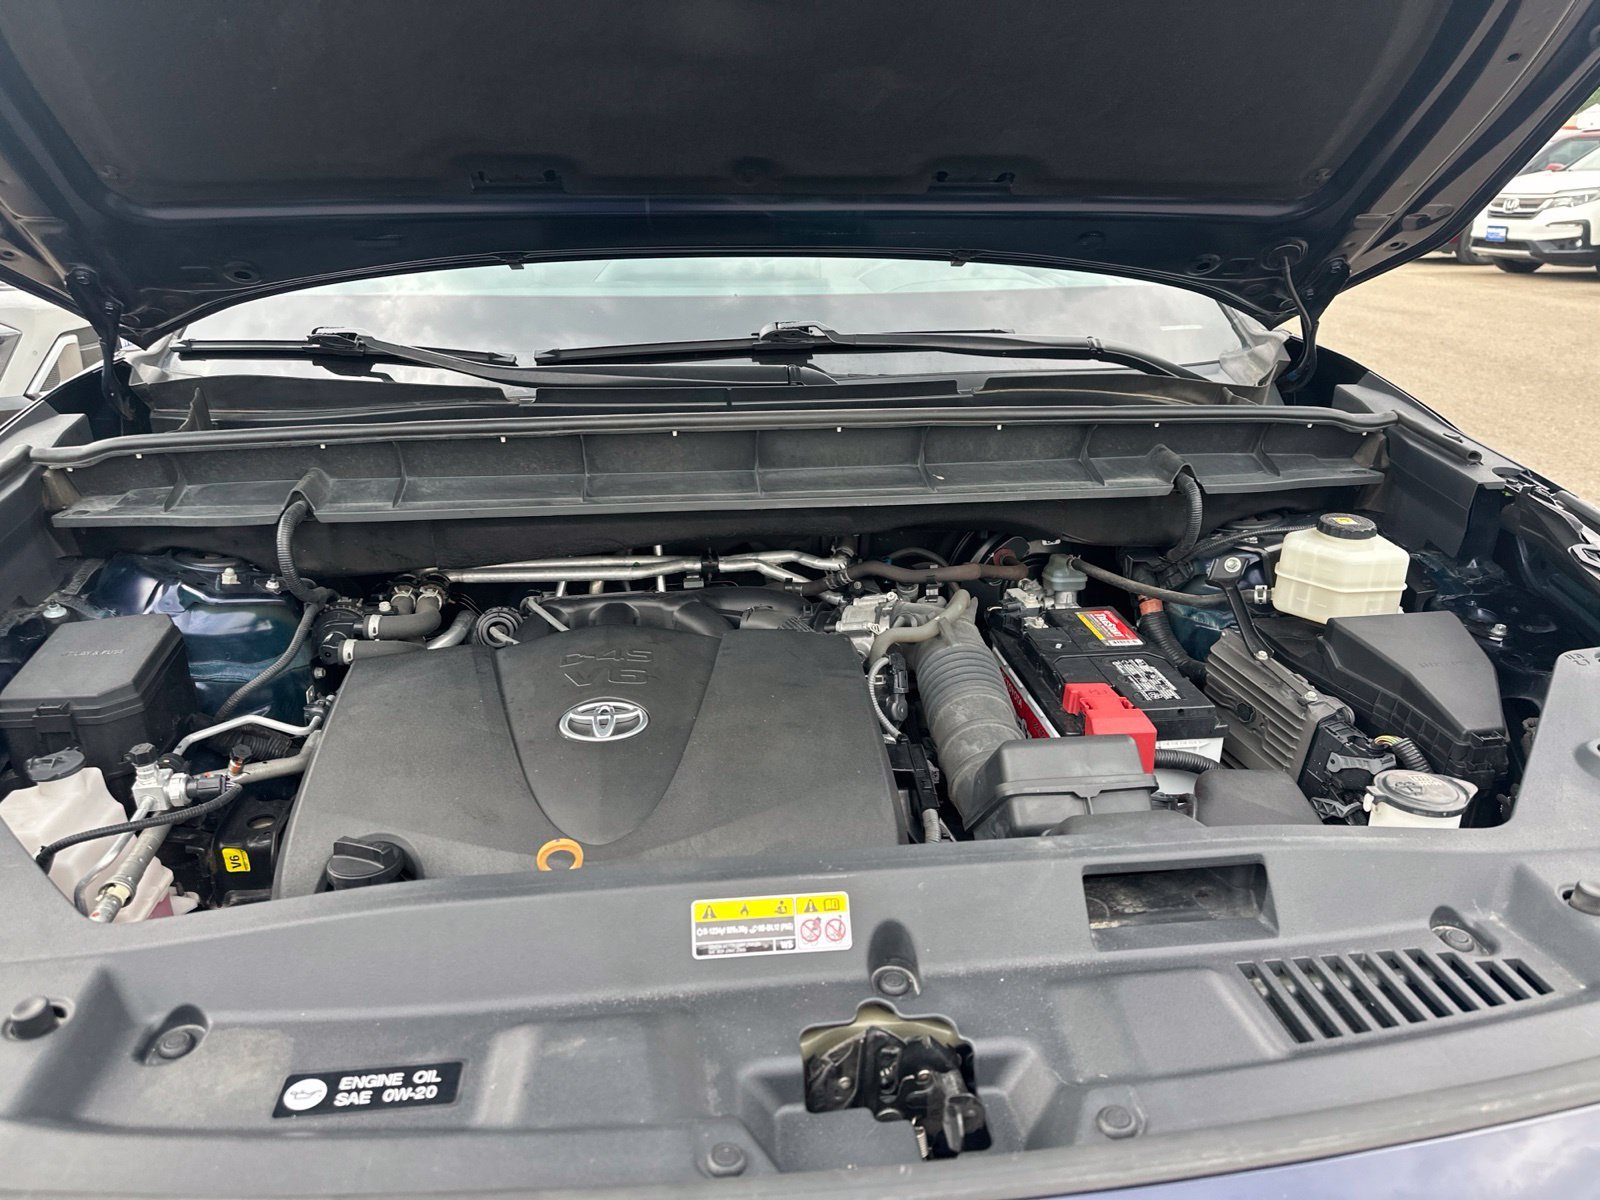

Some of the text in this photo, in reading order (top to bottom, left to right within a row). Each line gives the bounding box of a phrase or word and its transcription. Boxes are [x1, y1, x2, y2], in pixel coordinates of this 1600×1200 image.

[564, 669, 648, 687] V6
[229, 855, 242, 868] V6
[338, 1069, 442, 1091] ENGINE OIL
[333, 1084, 438, 1107] SAE 0W-20
